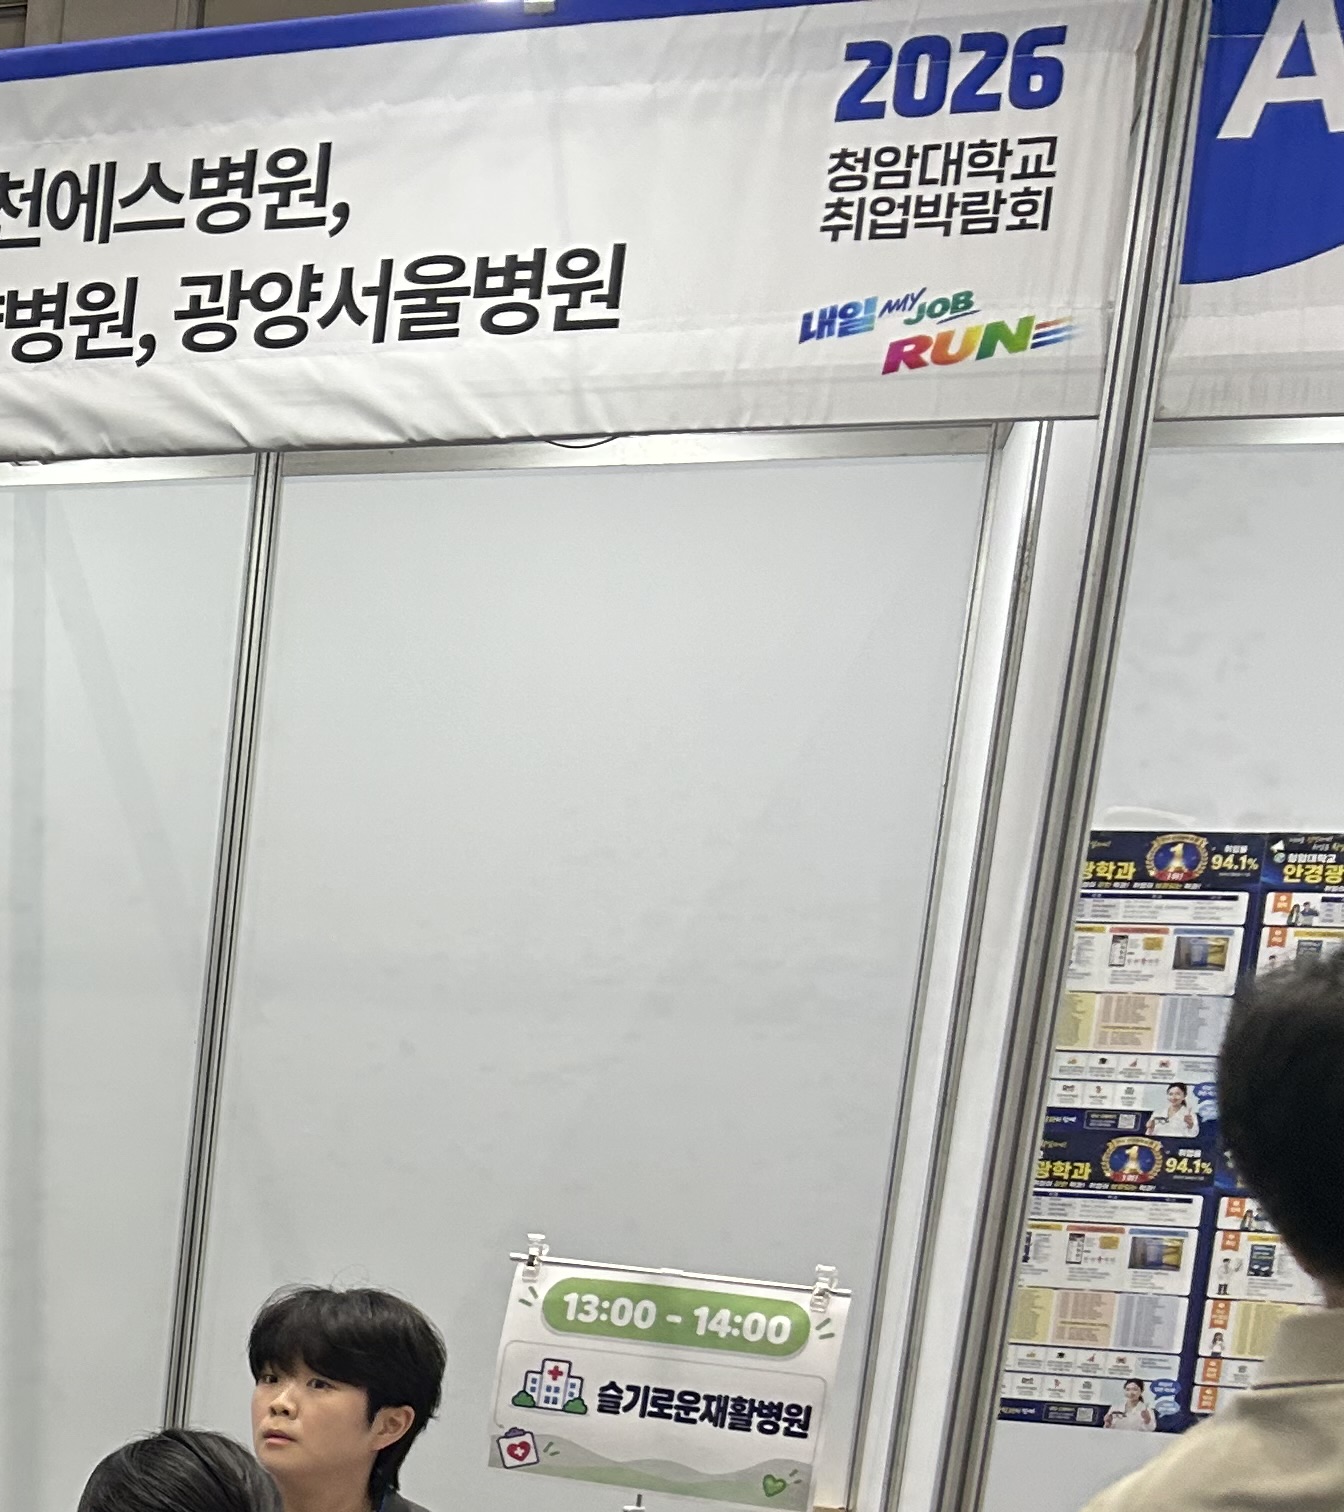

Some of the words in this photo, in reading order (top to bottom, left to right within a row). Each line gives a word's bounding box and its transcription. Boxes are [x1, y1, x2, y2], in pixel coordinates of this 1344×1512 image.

[834, 25, 1068, 122] 2026
[827, 136, 1057, 193] 청암대학교
[820, 187, 1053, 243] 취업박람회
[173, 243, 625, 352] 광양서울병원
[798, 295, 878, 344] 내일
[878, 287, 927, 318] MY
[903, 290, 975, 326] JOB
[882, 315, 1036, 375] RUN
[1211, 853, 1260, 872] 94.1%
[563, 1292, 657, 1329] 13:00
[693, 1306, 792, 1344] 14:00
[597, 1381, 812, 1439] 슬기로운재활병원
